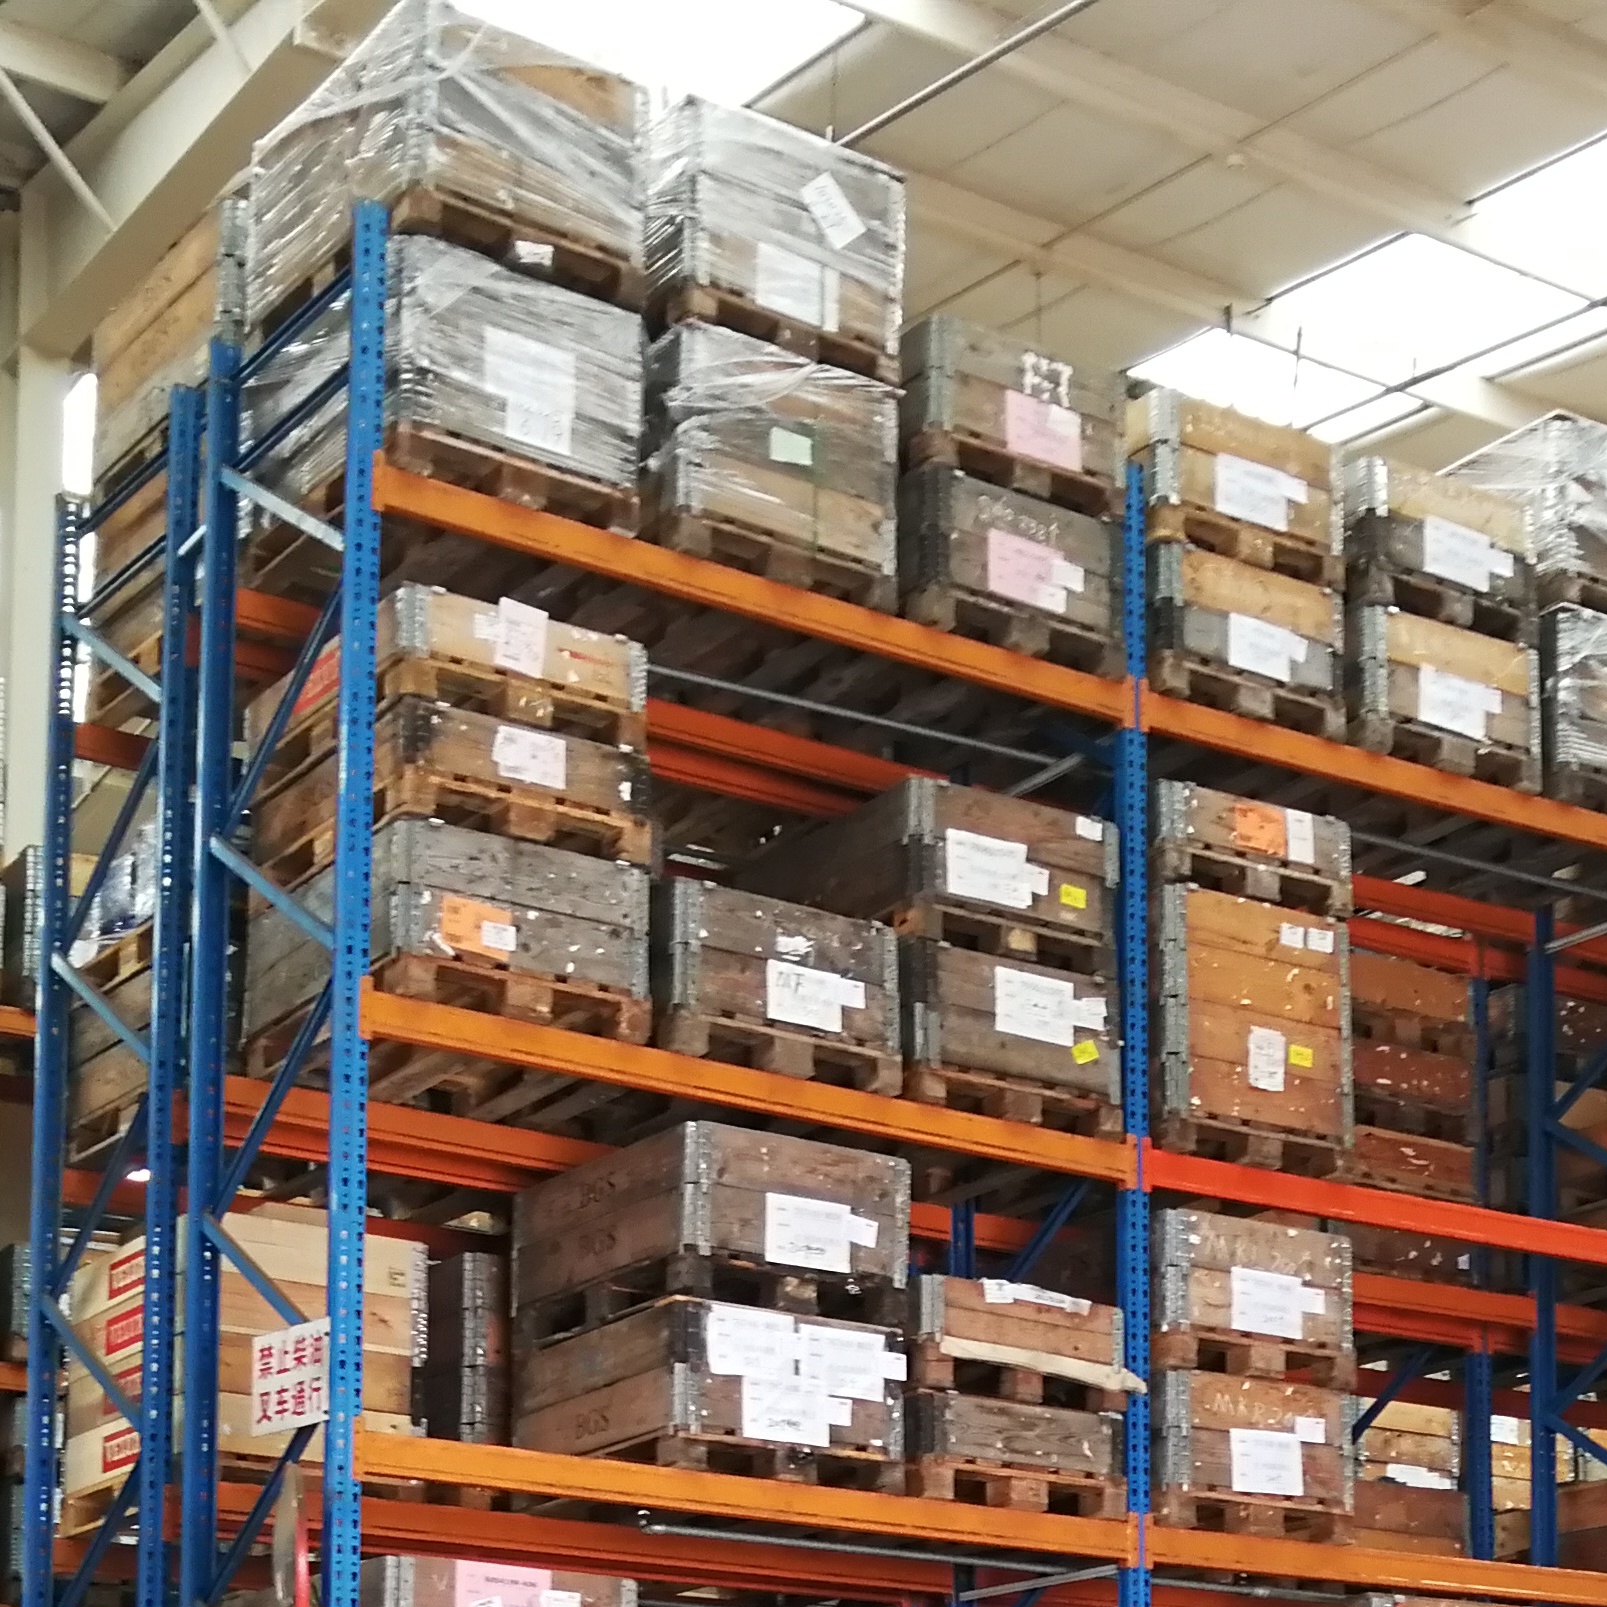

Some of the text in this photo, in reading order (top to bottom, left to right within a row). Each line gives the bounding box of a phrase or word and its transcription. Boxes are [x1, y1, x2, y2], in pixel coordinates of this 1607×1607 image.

[257, 1329, 323, 1380] 禁止柴油
[256, 1376, 323, 1424] 叉车通行
